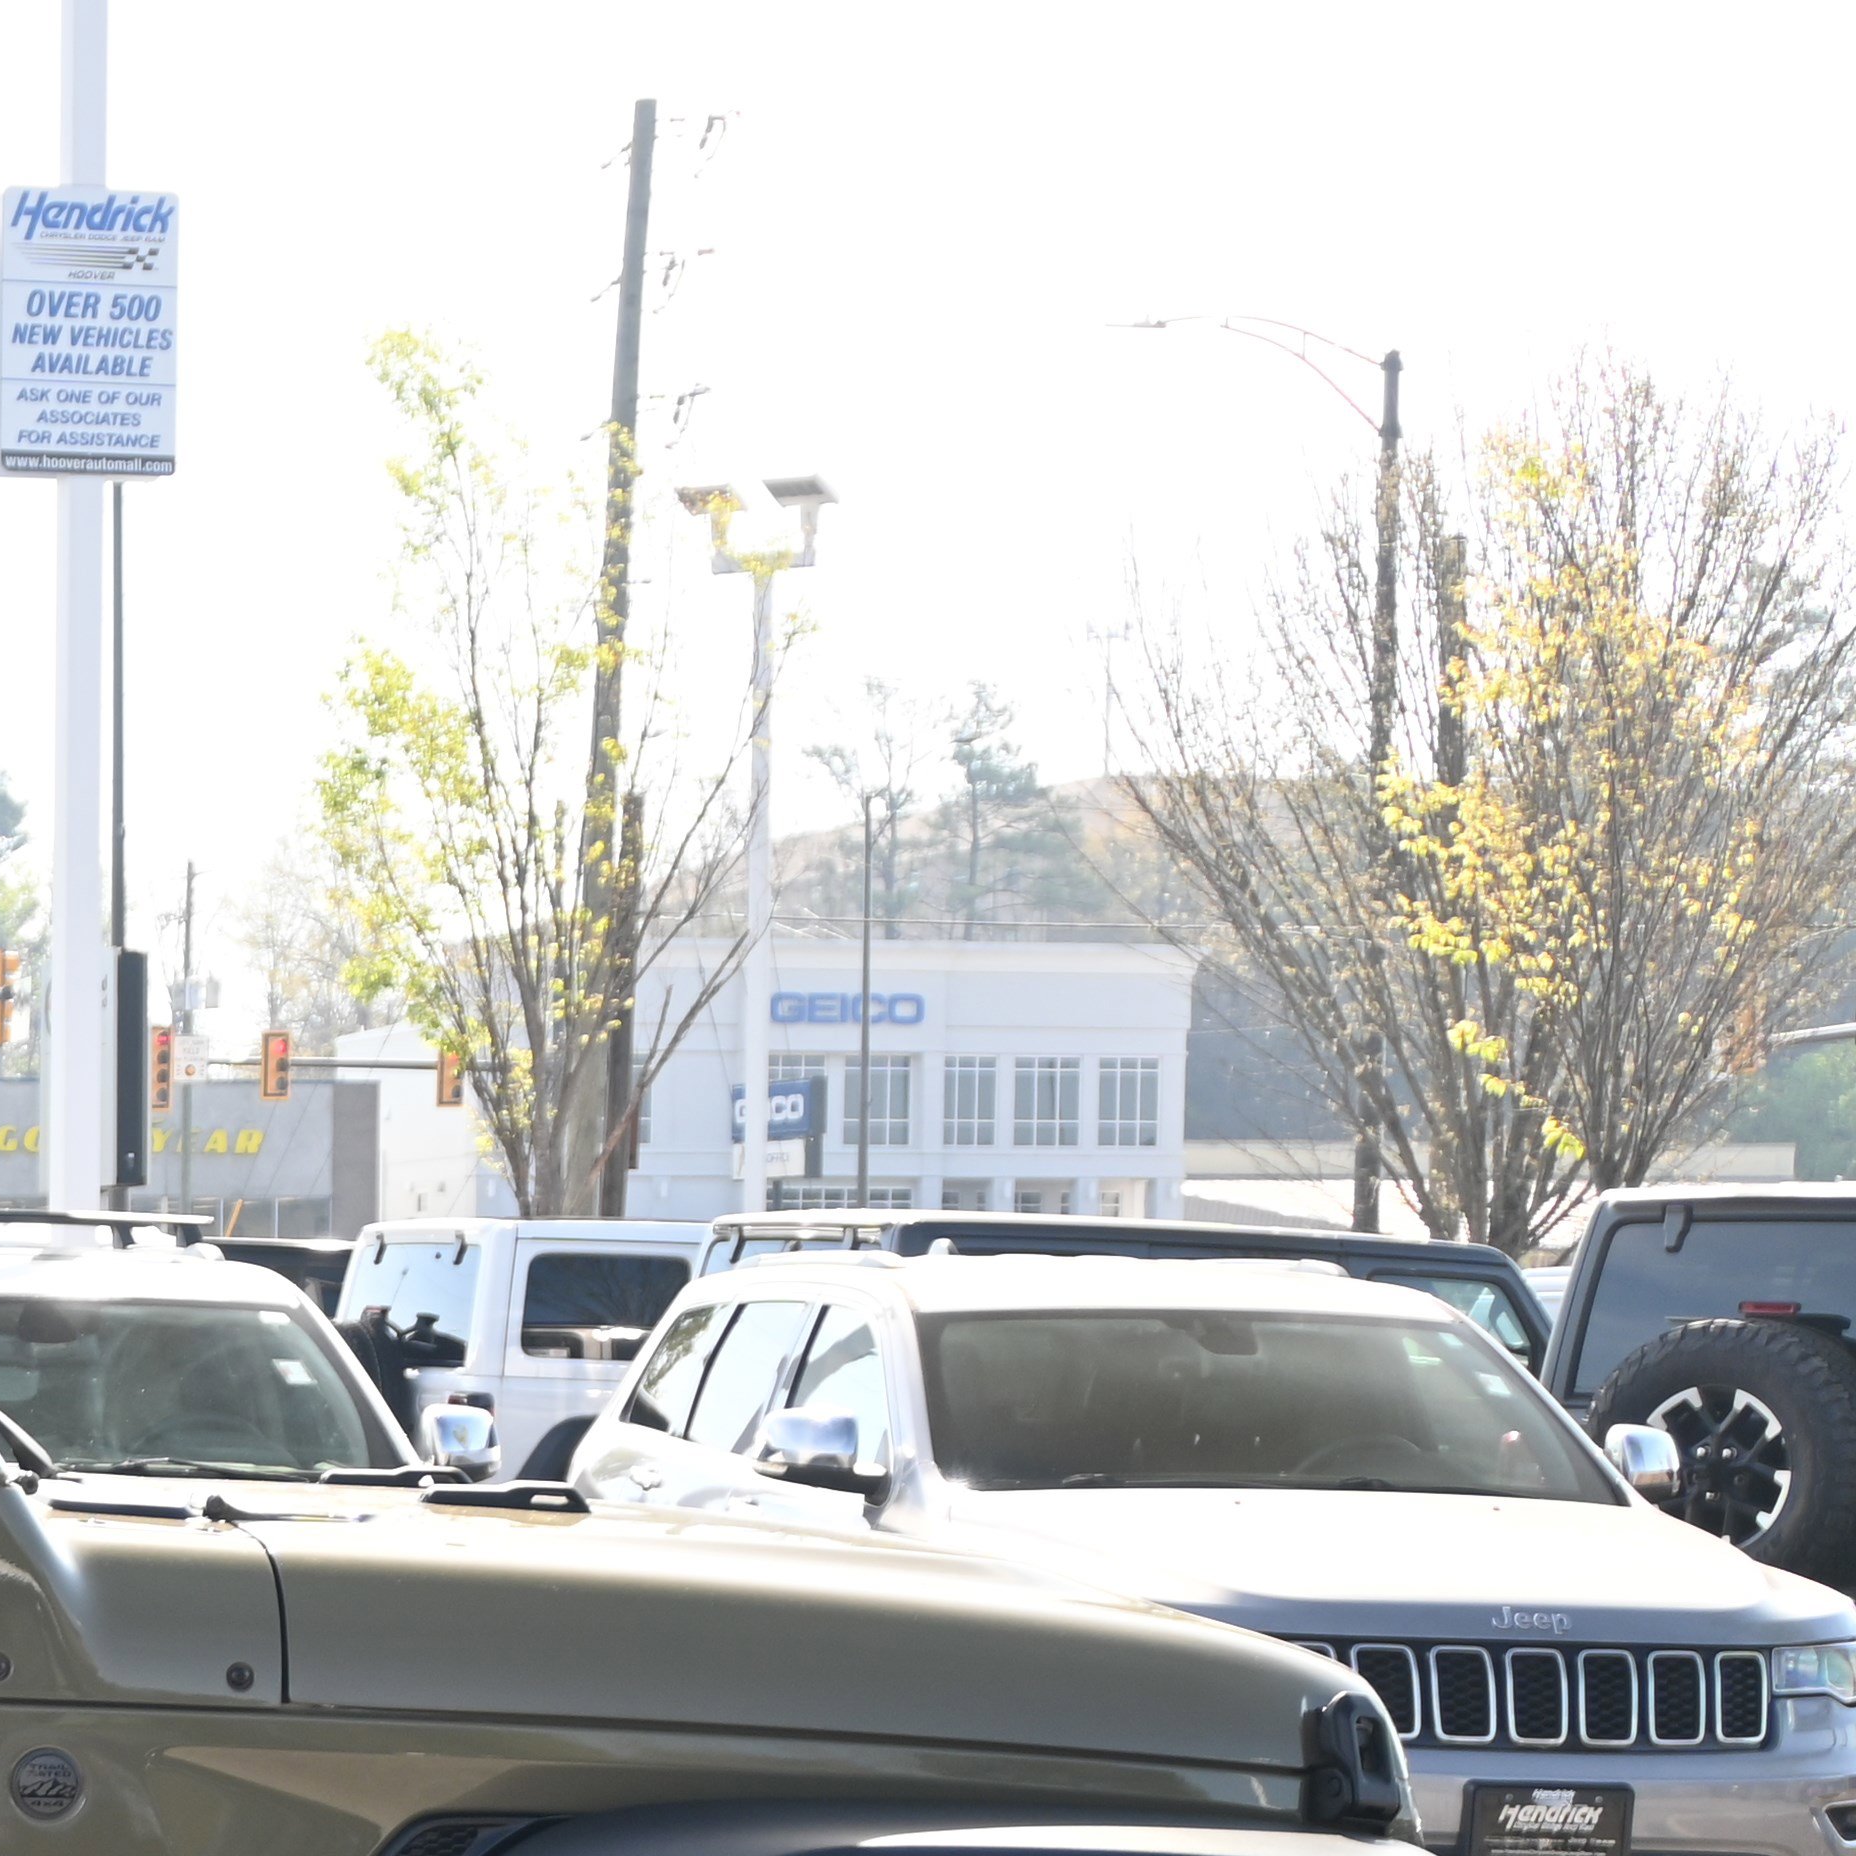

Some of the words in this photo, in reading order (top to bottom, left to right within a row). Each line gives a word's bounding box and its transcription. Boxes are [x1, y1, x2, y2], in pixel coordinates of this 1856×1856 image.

[10, 190, 175, 240] Hendrick
[68, 270, 116, 280] HOOVER
[26, 289, 101, 319] OVER
[109, 294, 162, 322] 500
[11, 323, 63, 345] NEW
[70, 325, 174, 350] VEHICLES
[31, 352, 154, 377] AVAILABLE
[16, 387, 51, 402] ASK
[56, 389, 93, 404] ONE
[98, 391, 121, 405] OF
[125, 392, 162, 407] OUR
[36, 409, 142, 427] ASSOCIATES
[17, 430, 52, 445] FOR
[56, 432, 161, 448] ASSISTANCE
[5, 454, 173, 473] www.hooverautomall.com
[771, 992, 925, 1024] GEICO
[735, 1093, 804, 1123] GCO
[1491, 1606, 1572, 1634] Jeep
[1498, 1804, 1603, 1832] Hendrick
